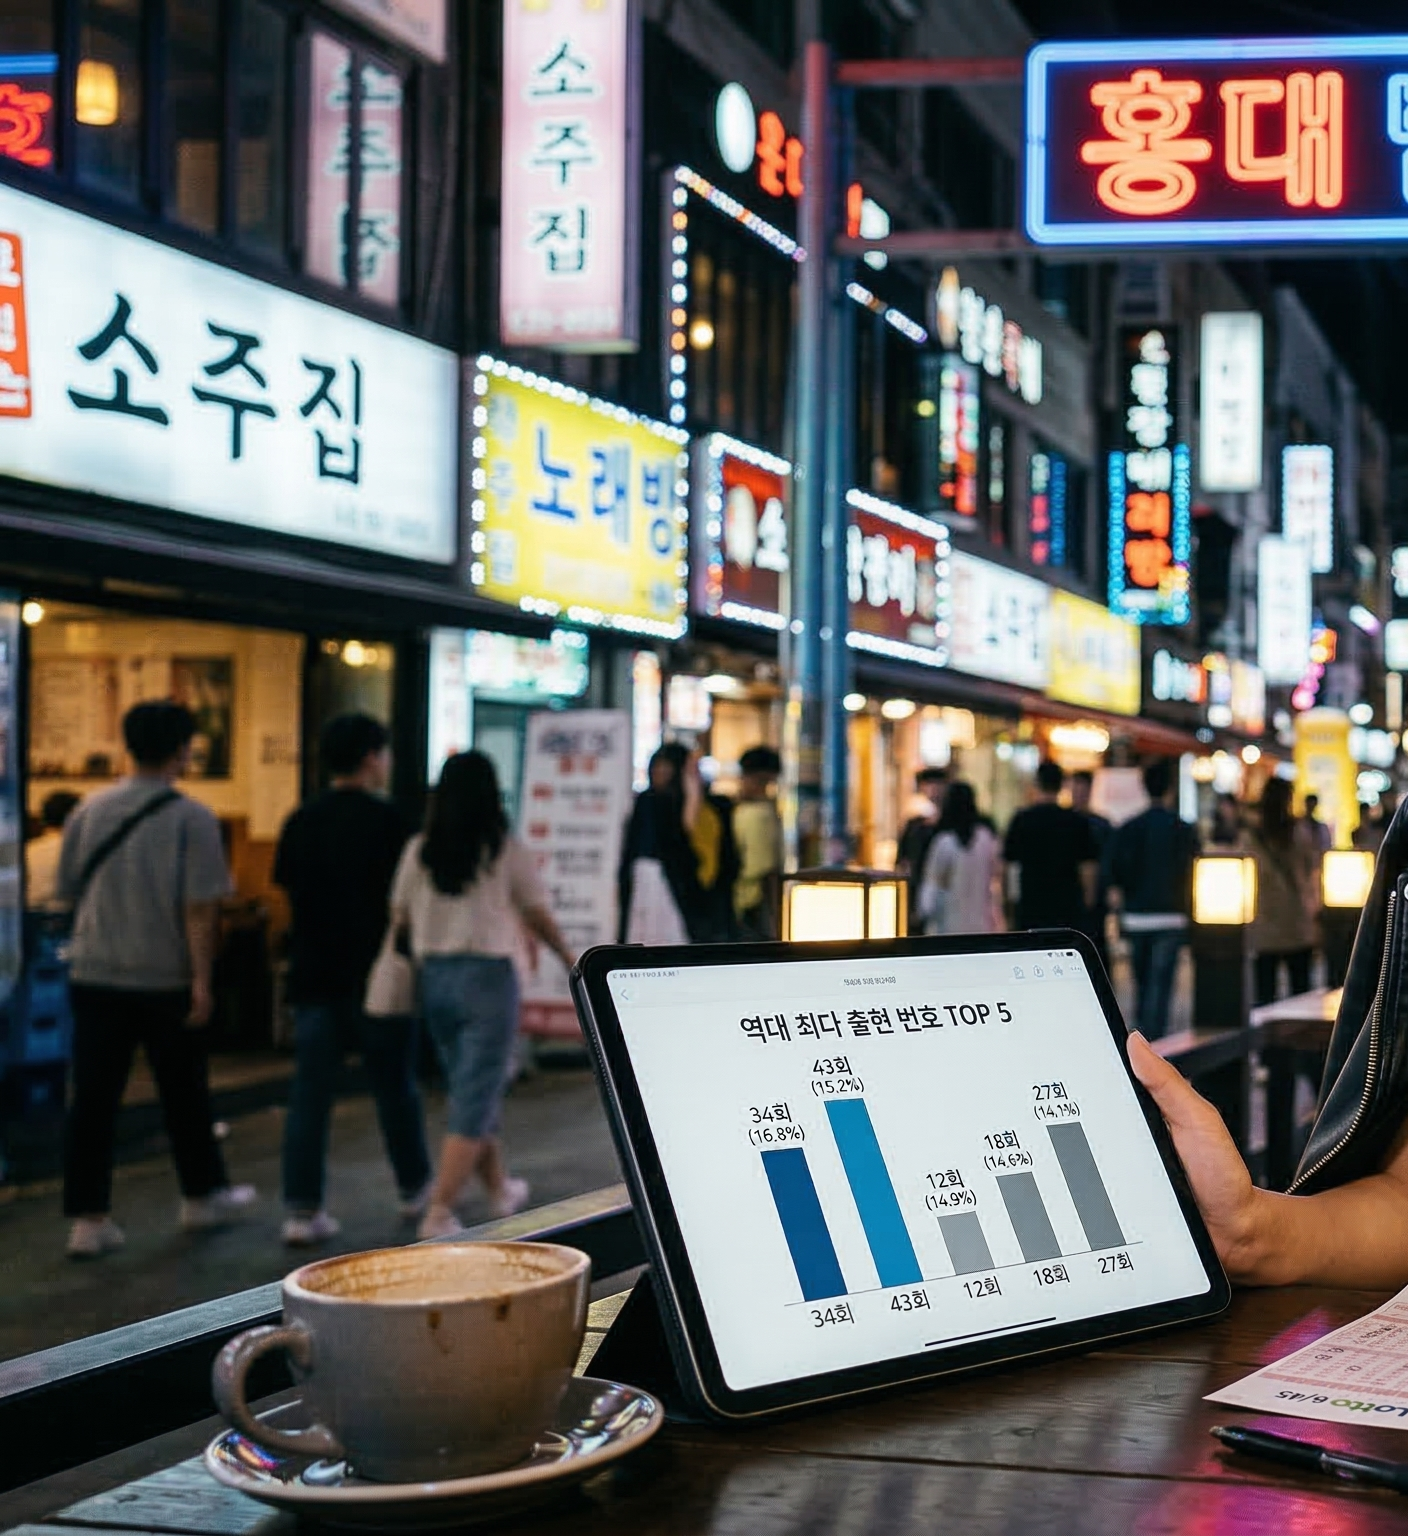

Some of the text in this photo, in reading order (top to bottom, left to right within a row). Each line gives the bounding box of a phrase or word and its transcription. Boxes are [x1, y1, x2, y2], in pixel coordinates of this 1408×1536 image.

[1081, 69, 1345, 215] 홍대
[531, 42, 593, 273] 소주집
[67, 293, 362, 485] 소주집
[530, 425, 675, 554] 노래방
[740, 1002, 1012, 1043] 역대 최다 출현 번호 TOP 5
[812, 1056, 853, 1075] 43회
[811, 1077, 865, 1096] (15.2%)
[1032, 1081, 1069, 1100] 27회
[749, 1102, 792, 1123] 34회
[748, 1125, 805, 1145] (16.8%)
[984, 1130, 1020, 1149] 18회
[926, 1169, 965, 1189] 12회
[925, 1189, 977, 1211] (14.9%)
[811, 1252, 1134, 1328] 34회 43회 12회 18회 27회
